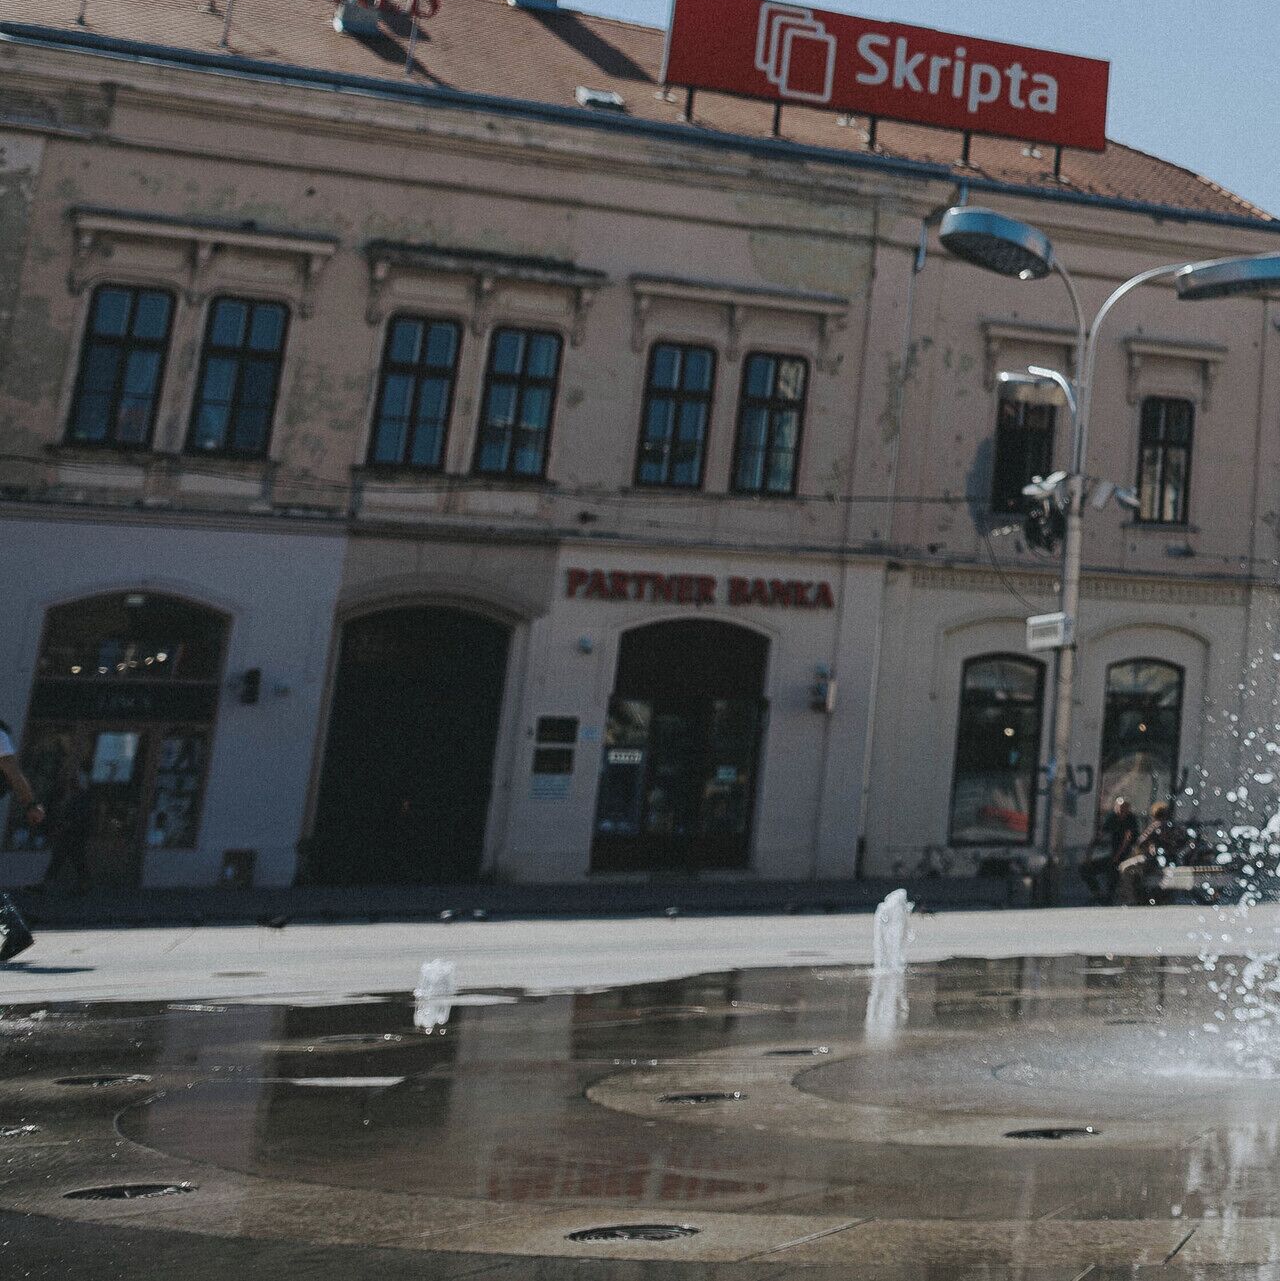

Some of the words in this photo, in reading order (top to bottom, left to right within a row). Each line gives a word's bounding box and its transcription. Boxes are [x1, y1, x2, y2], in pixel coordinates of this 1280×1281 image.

[855, 33, 1059, 114] Skripta
[565, 568, 717, 606] PARTNER
[726, 575, 836, 610] BANKA
